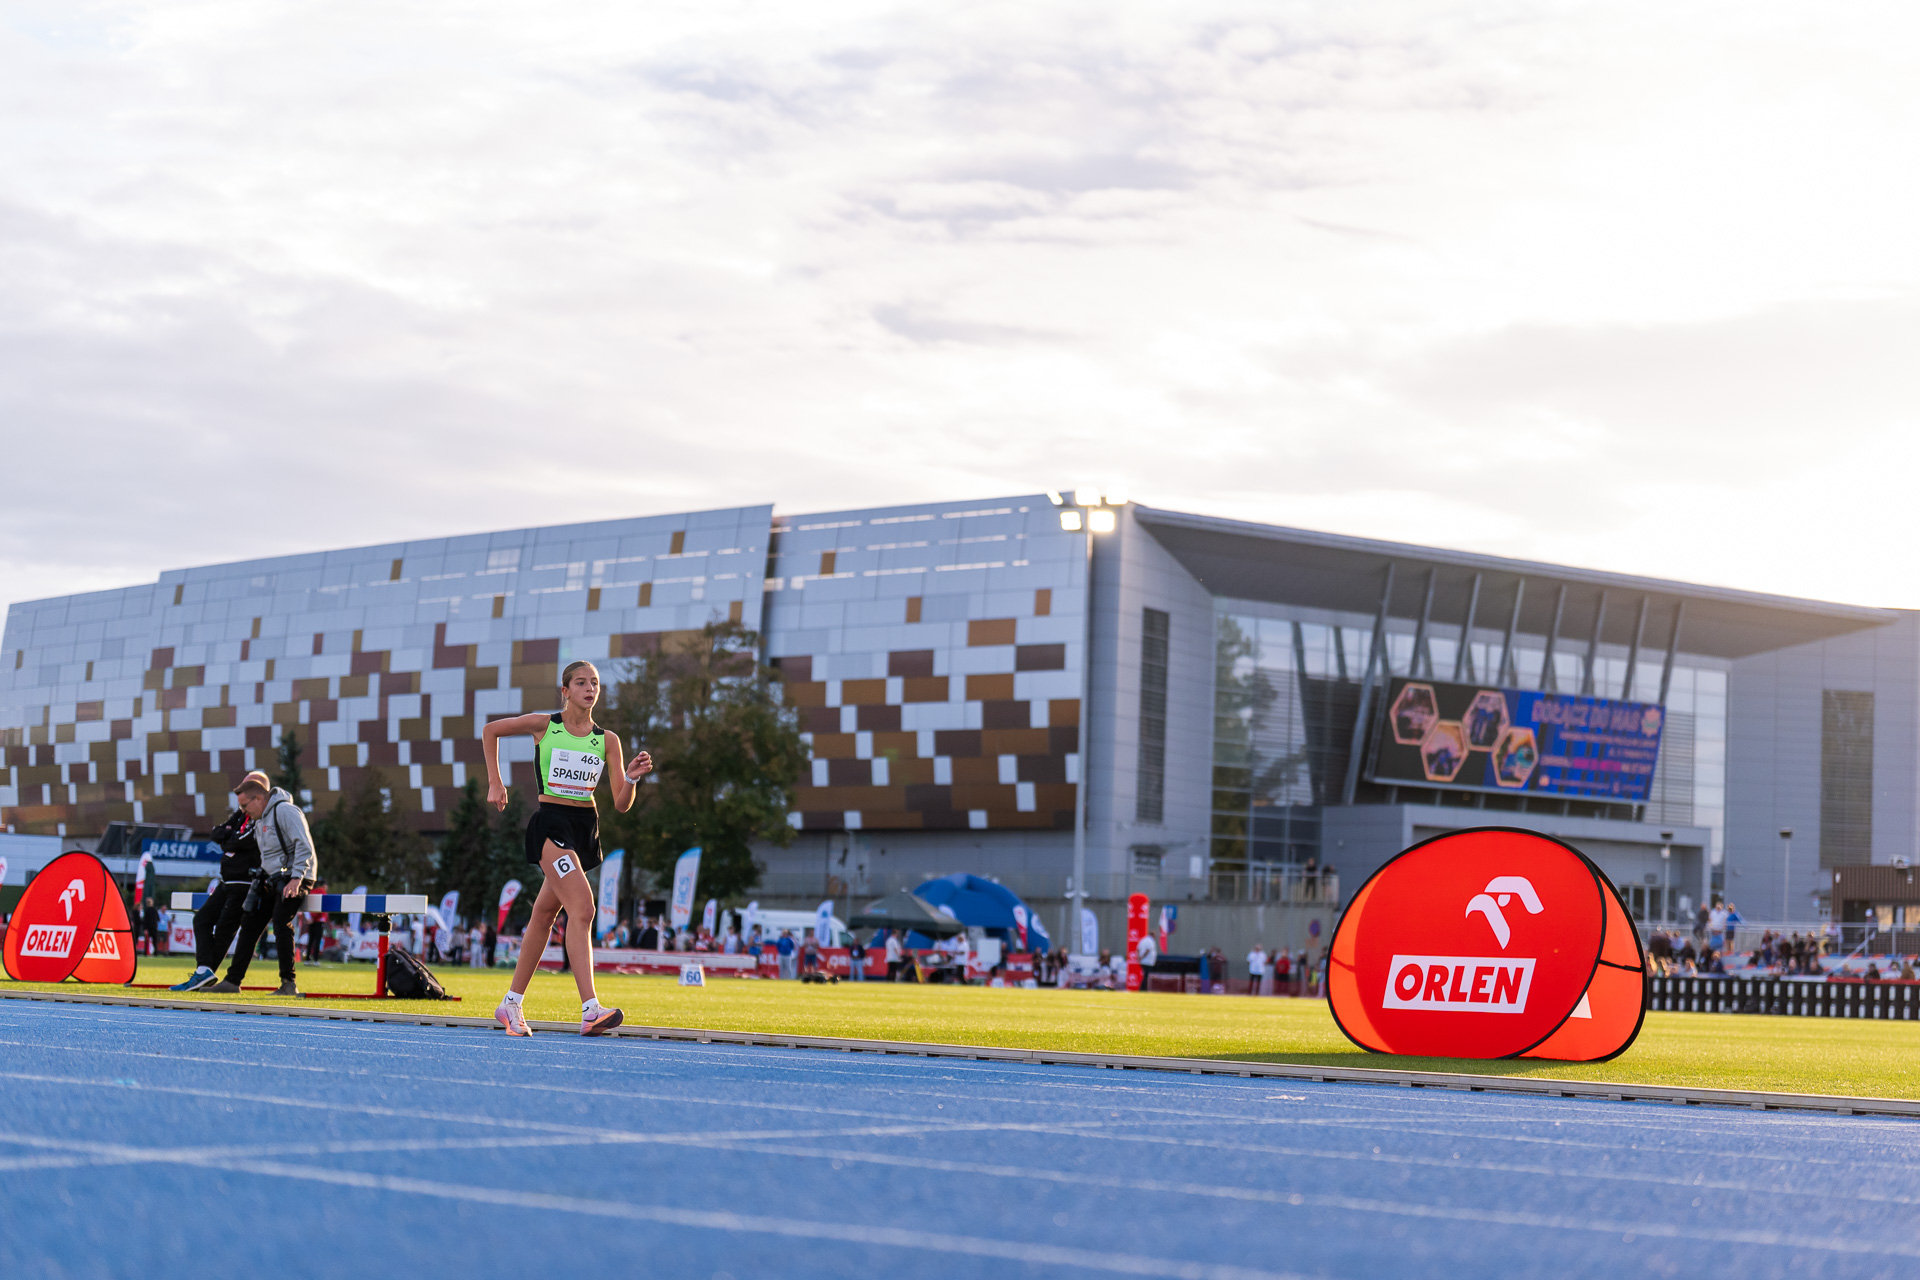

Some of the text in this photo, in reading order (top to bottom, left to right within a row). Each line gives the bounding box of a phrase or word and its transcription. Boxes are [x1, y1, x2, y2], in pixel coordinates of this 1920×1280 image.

[581, 754, 600, 766] 463
[552, 767, 598, 782] SPASIUK
[149, 842, 199, 858] BASEN
[557, 858, 570, 873] 6
[26, 930, 73, 953] ORLEN
[686, 970, 702, 983] 60
[1394, 963, 1525, 1004] ORLEN
